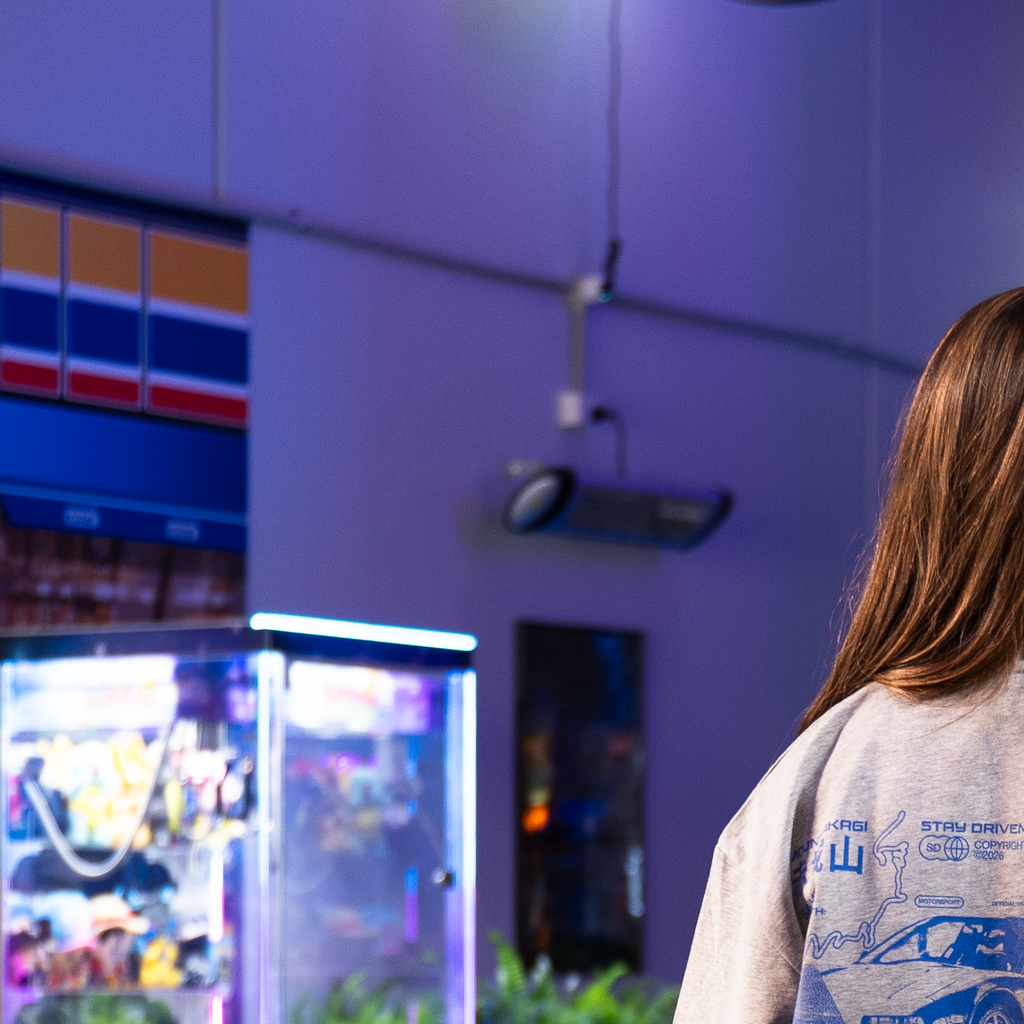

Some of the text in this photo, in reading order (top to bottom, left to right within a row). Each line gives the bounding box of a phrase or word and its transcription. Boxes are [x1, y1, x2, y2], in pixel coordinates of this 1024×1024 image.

[826, 820, 869, 832] KAGI
[921, 821, 967, 833] STAY
[926, 843, 942, 852] SD
